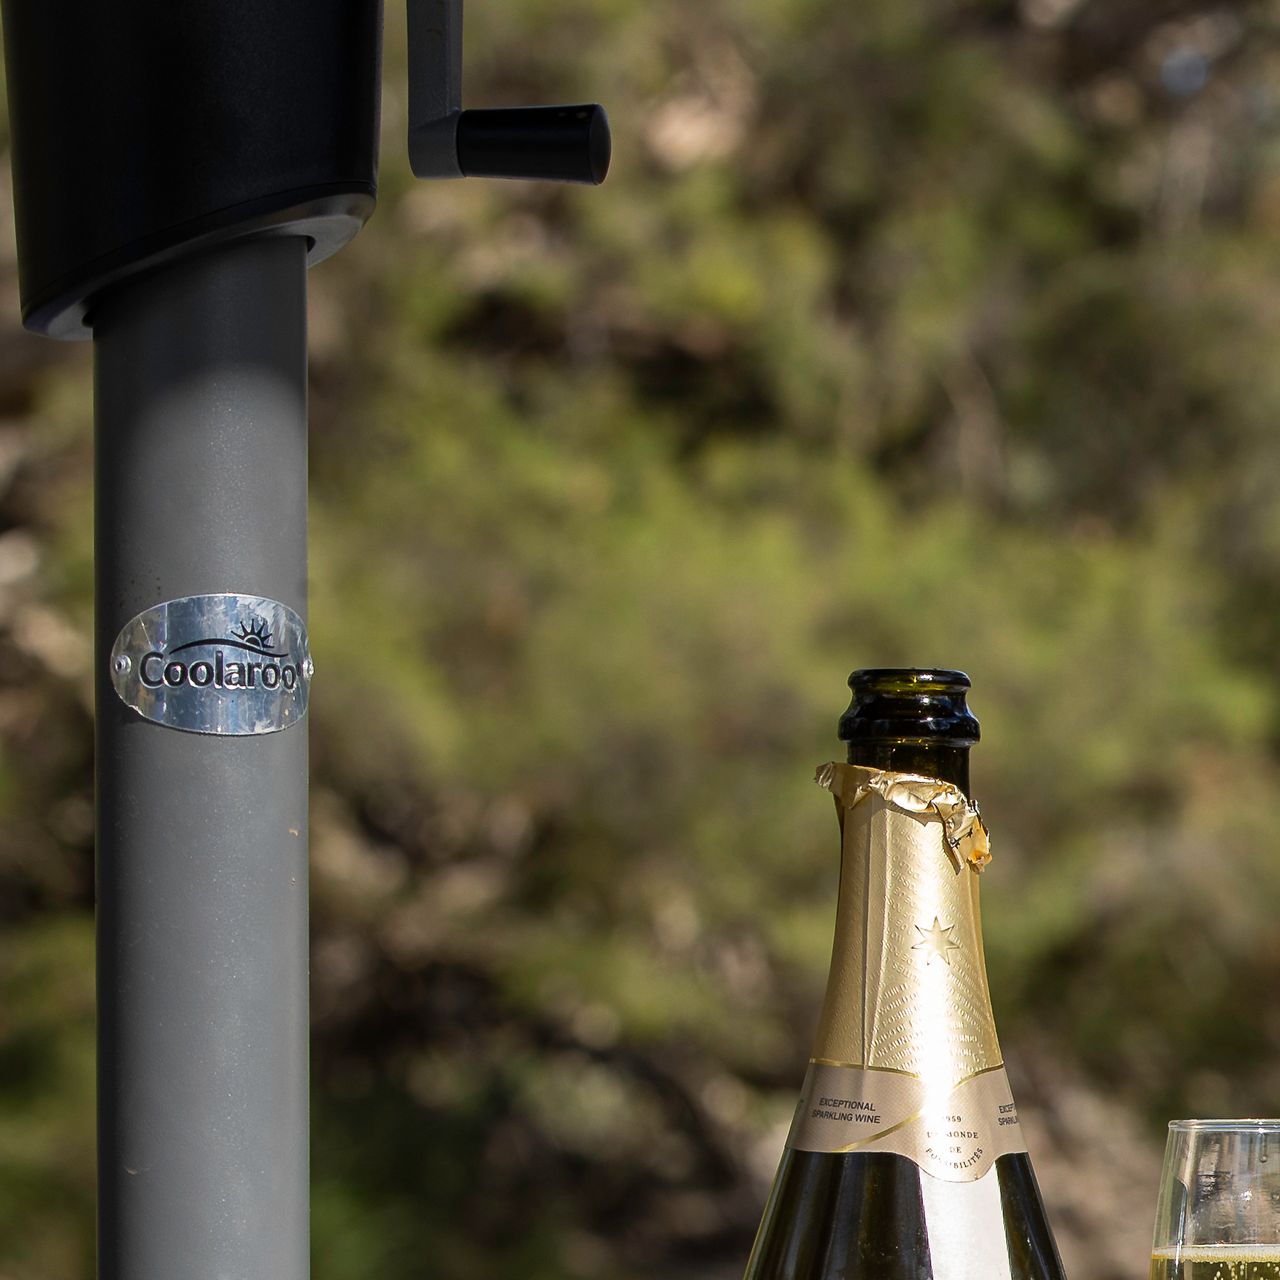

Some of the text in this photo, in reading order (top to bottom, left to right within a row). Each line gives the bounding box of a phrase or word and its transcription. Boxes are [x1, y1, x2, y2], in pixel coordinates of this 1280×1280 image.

[139, 651, 297, 689] Coolaroo
[819, 1097, 876, 1112] EXCEPTIONAL
[811, 1110, 881, 1124] SPARKLING WINE
